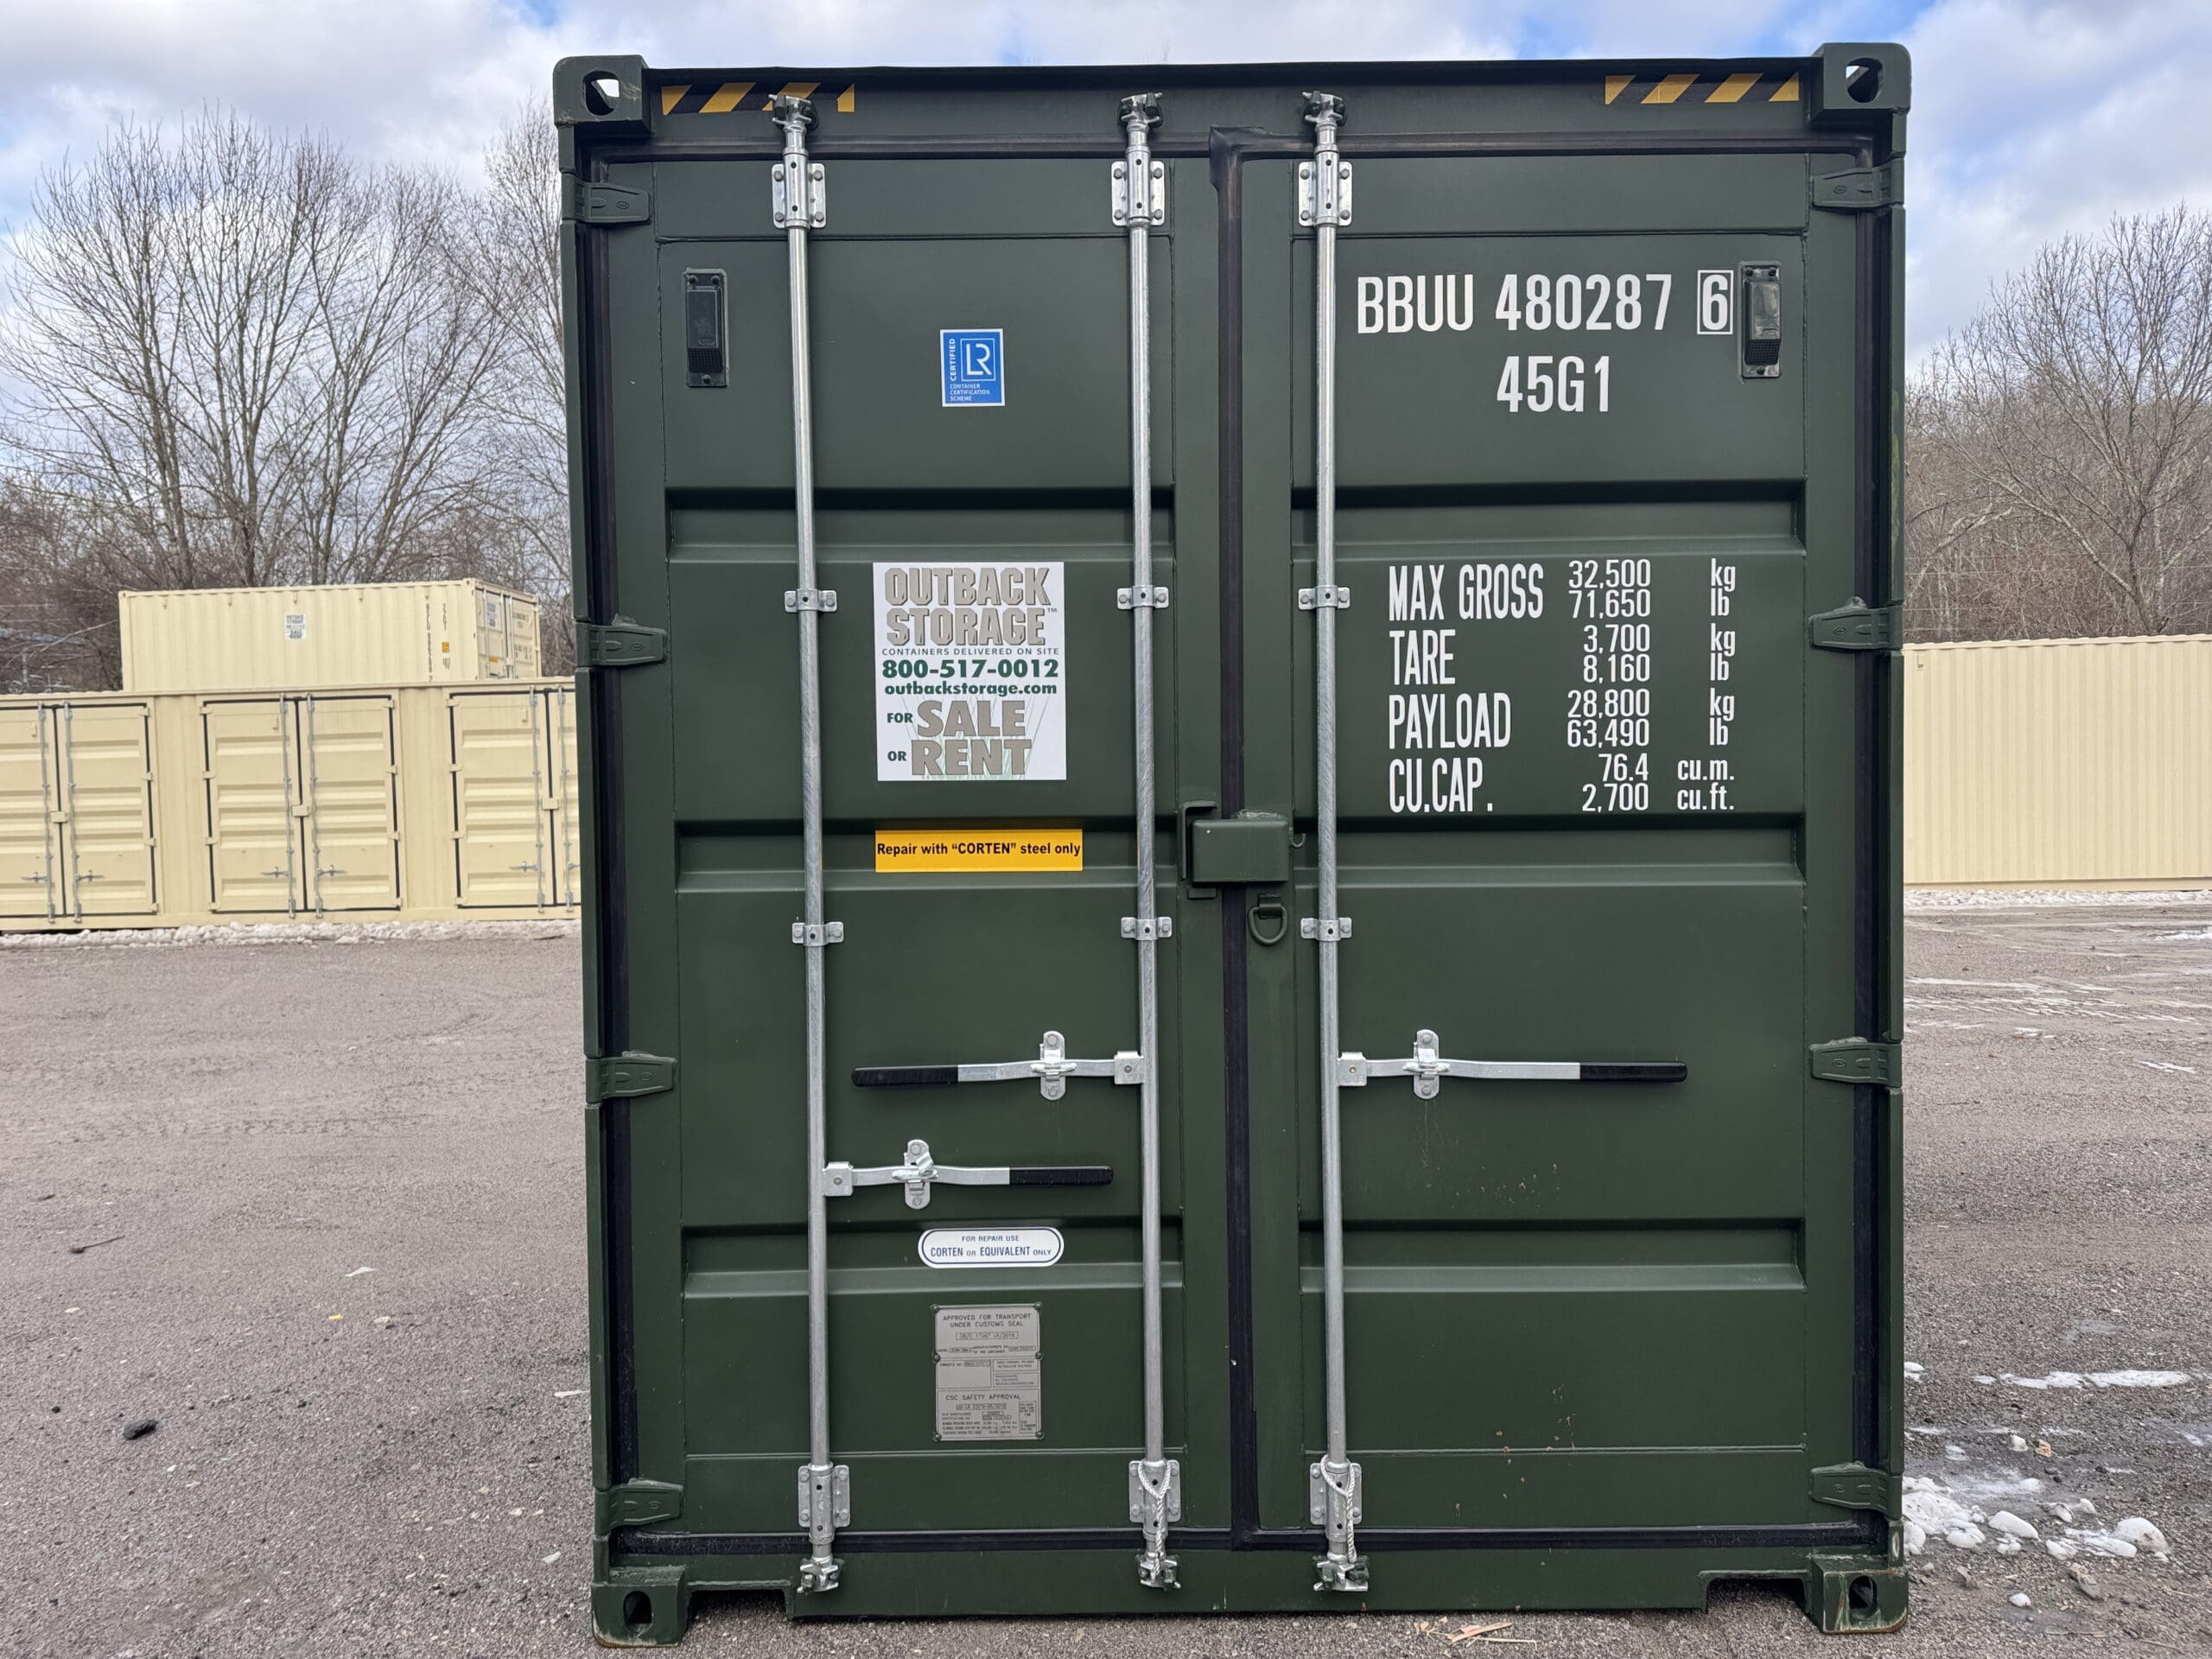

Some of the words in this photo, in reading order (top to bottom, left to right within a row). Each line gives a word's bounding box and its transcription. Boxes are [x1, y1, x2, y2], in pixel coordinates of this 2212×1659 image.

[1357, 274, 1474, 334] BBUU
[1495, 273, 1672, 332] 480287
[1701, 273, 1729, 332] 6
[966, 343, 993, 376] LR
[1497, 355, 1611, 413] 45G1
[884, 567, 1051, 606] OUTBACK
[1389, 564, 1445, 621] MAX
[1459, 563, 1544, 620] GROSS
[1568, 558, 1651, 588] 32,500
[1711, 557, 1736, 592] kg
[1568, 588, 1651, 619] 71,650
[1711, 588, 1729, 616] lb
[886, 607, 1046, 646] STORAGE
[882, 659, 1058, 678] 800-517-0012
[1389, 629, 1456, 685] TARE
[1583, 624, 1650, 654] 3,700
[1710, 623, 1736, 657] kg
[1583, 654, 1650, 683] 8,160
[1710, 653, 1729, 681] lb
[884, 681, 1058, 697] outbackstorage.com
[887, 712, 913, 724] FOR
[917, 700, 1026, 738] SALE
[1389, 692, 1511, 749] PAYLOAD
[1567, 689, 1649, 719] 28,800
[1709, 688, 1735, 721] kg
[1567, 719, 1649, 747] 63,490
[1709, 718, 1728, 746] lb
[887, 751, 906, 762] OR
[911, 739, 1033, 776] RENT
[1599, 753, 1649, 782] 76.4
[1677, 759, 1734, 781] cu.m.
[1582, 783, 1649, 813] 2,700
[1676, 783, 1735, 810] cu.ft.
[877, 843, 918, 857] Repair
[921, 843, 948, 855] with
[1020, 842, 1051, 854] steel
[1054, 842, 1081, 856] only
[931, 1247, 963, 1257] CORTEN
[980, 1246, 1031, 1256] EQUIVALENT
